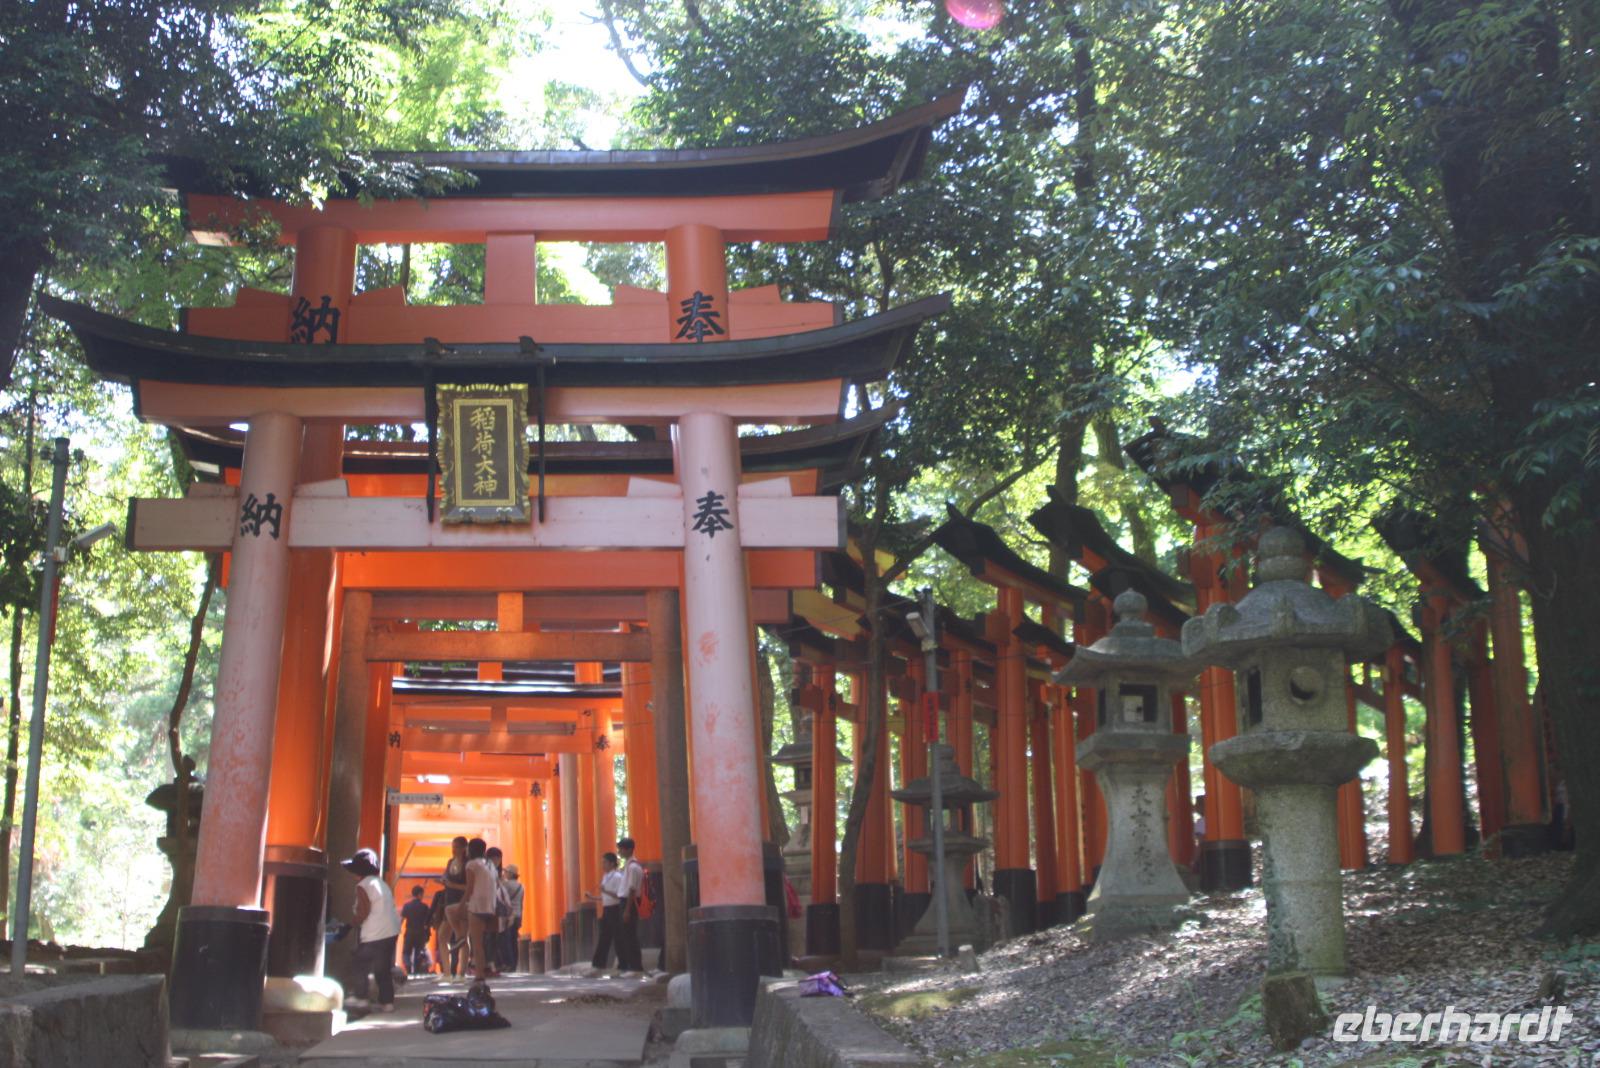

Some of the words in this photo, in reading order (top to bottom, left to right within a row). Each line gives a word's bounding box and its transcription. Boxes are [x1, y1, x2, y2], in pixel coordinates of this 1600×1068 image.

[291, 295, 341, 345] 納
[676, 290, 726, 344] 奉
[240, 492, 283, 541] 納
[692, 490, 734, 539] 奉
